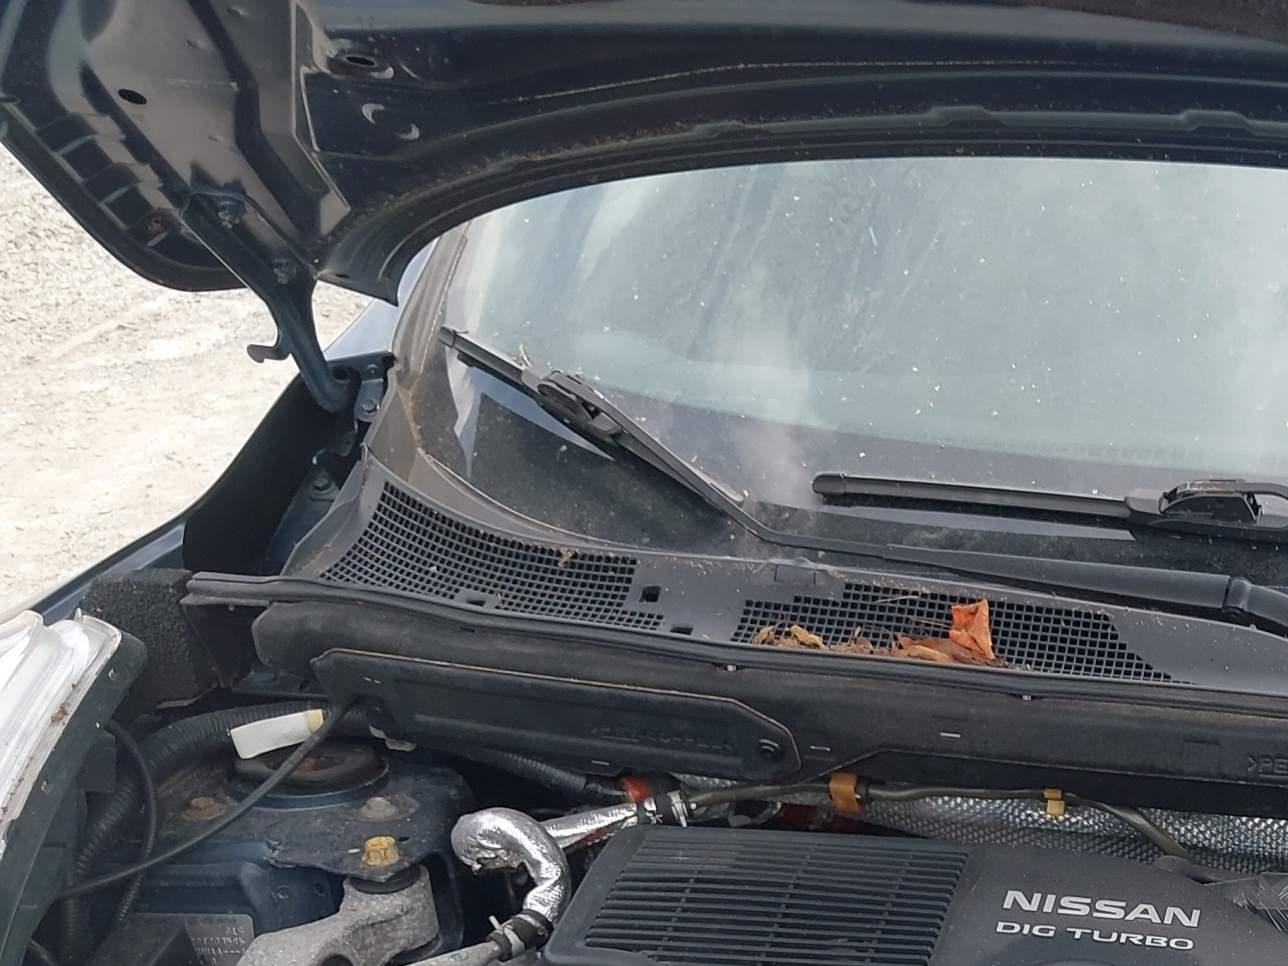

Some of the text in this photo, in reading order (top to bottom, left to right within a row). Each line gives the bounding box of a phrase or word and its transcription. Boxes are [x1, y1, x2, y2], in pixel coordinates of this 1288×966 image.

[1002, 890, 1201, 928] NISSAN
[996, 921, 1194, 950] DIG TURBO
